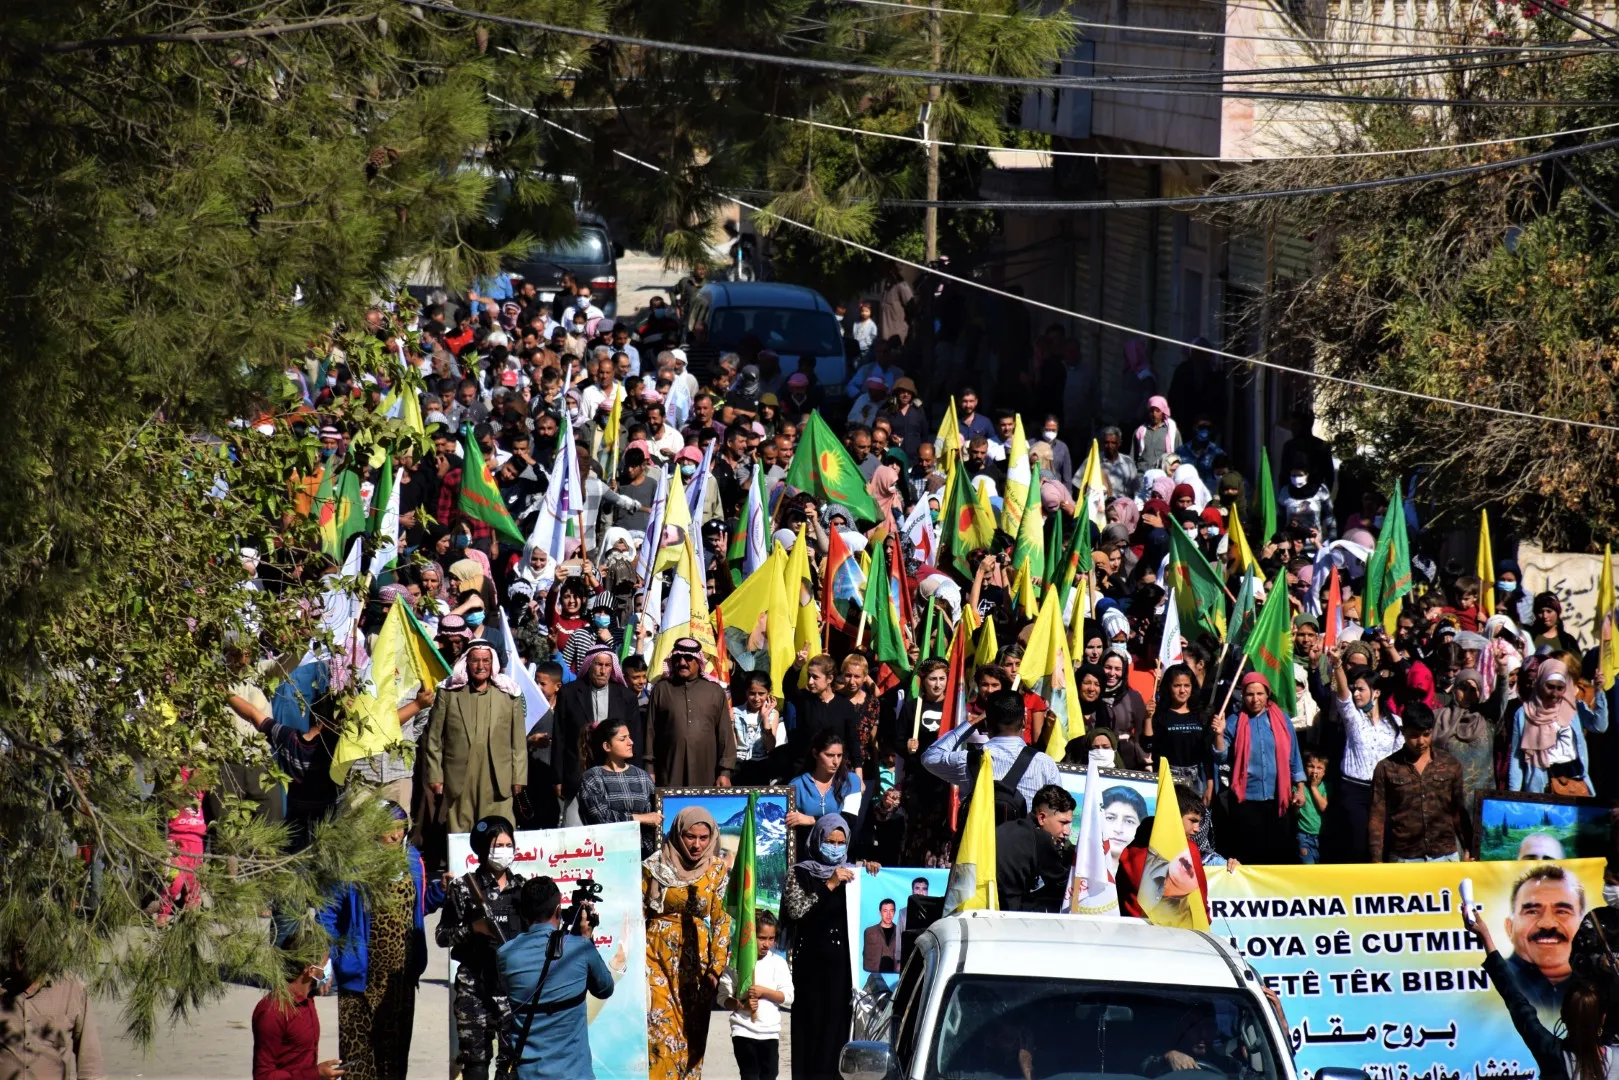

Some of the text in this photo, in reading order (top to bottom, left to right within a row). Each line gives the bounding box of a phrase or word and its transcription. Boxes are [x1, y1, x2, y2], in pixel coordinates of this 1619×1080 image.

[465, 838, 605, 868] ياشعبي العظم
[1355, 890, 1451, 915] IMRALÎ
[1315, 931, 1351, 955] 9Ê
[1330, 969, 1392, 994] TÊK
[1402, 970, 1489, 993] BIBIN
[1383, 1019, 1457, 1049] بروح
